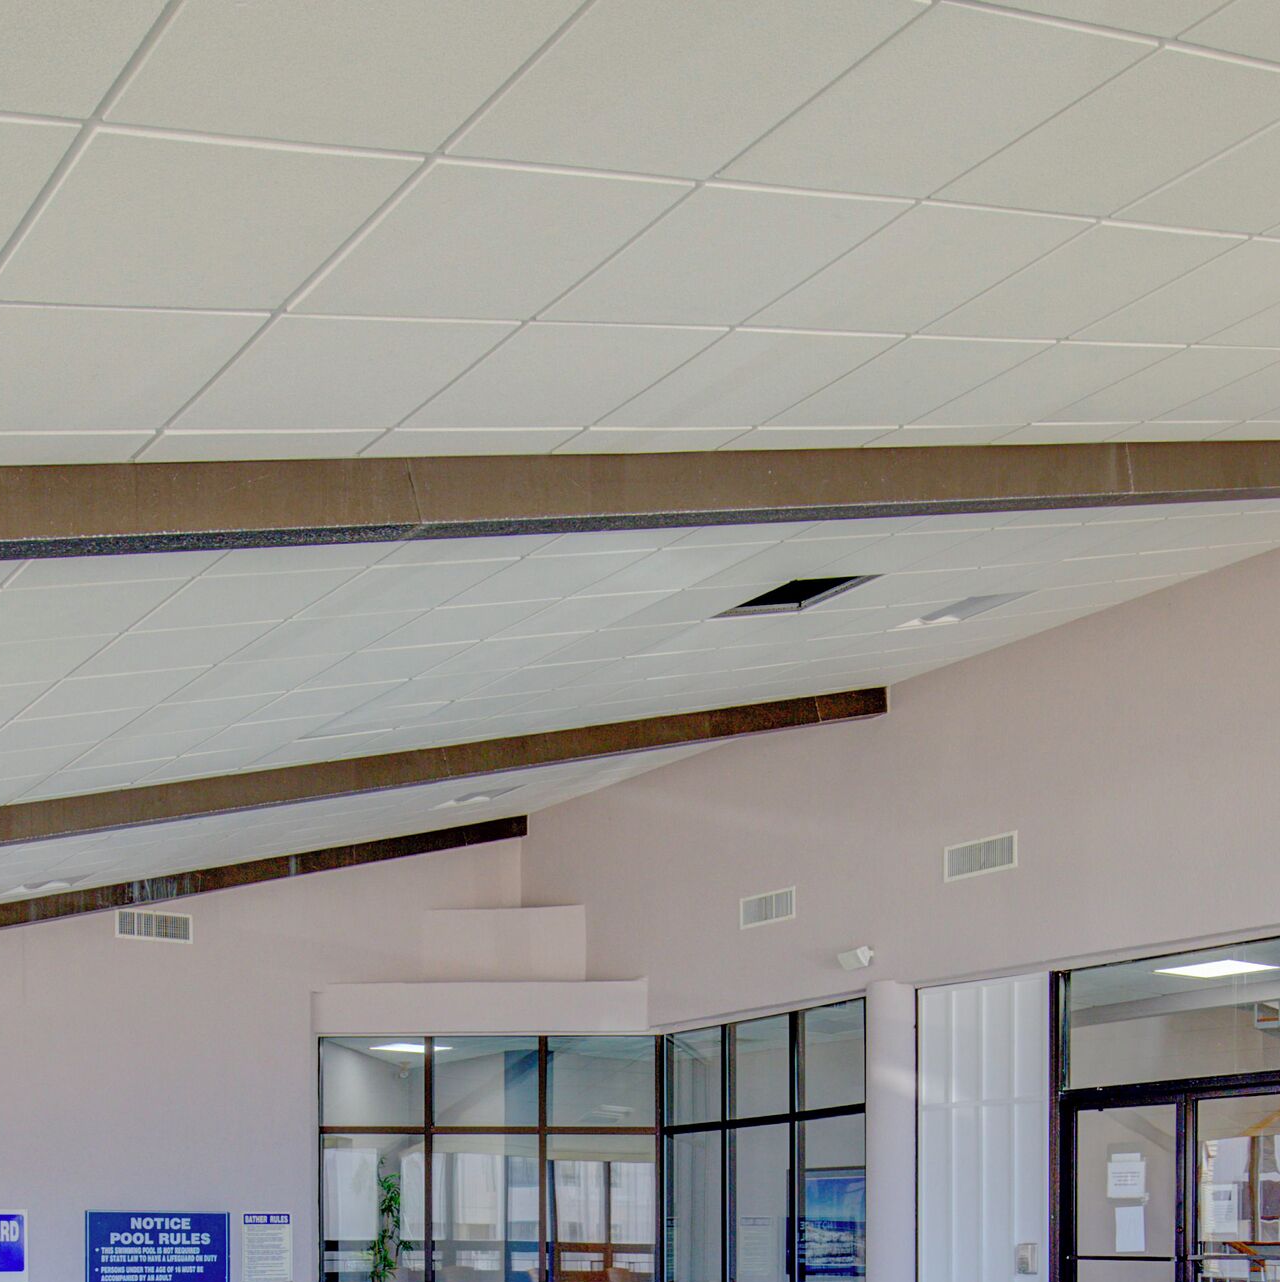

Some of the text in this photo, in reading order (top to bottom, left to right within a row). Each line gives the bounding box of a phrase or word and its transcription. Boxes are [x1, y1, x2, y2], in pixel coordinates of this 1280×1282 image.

[130, 1217, 191, 1230] NOTICE
[245, 1215, 288, 1223] BATHER RULES
[110, 1232, 211, 1245] POOL RULES
